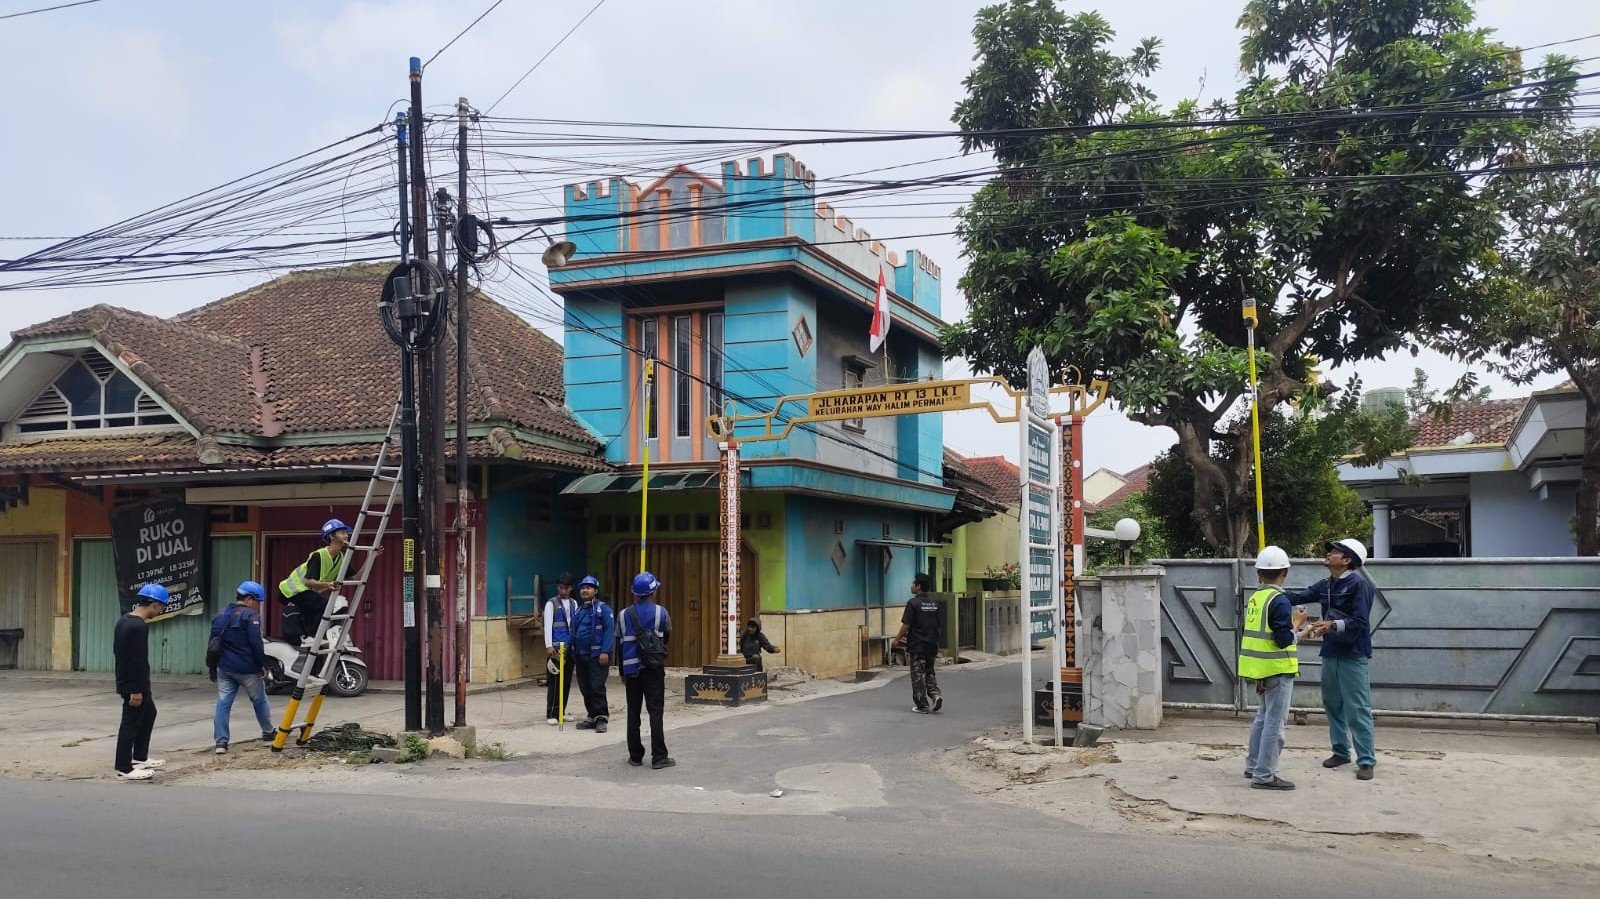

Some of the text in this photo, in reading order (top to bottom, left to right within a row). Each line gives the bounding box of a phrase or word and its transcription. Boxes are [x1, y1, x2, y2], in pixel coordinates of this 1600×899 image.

[816, 405, 863, 416] KELURAHAN
[866, 403, 881, 412] WAY
[885, 401, 910, 410] HALIM
[913, 398, 944, 407] PERMAI
[834, 393, 887, 406] HARAPAN
[895, 391, 909, 401] RT
[916, 389, 926, 399] 13
[140, 519, 184, 544] RUKO
[136, 536, 192, 564] DI JUAL
